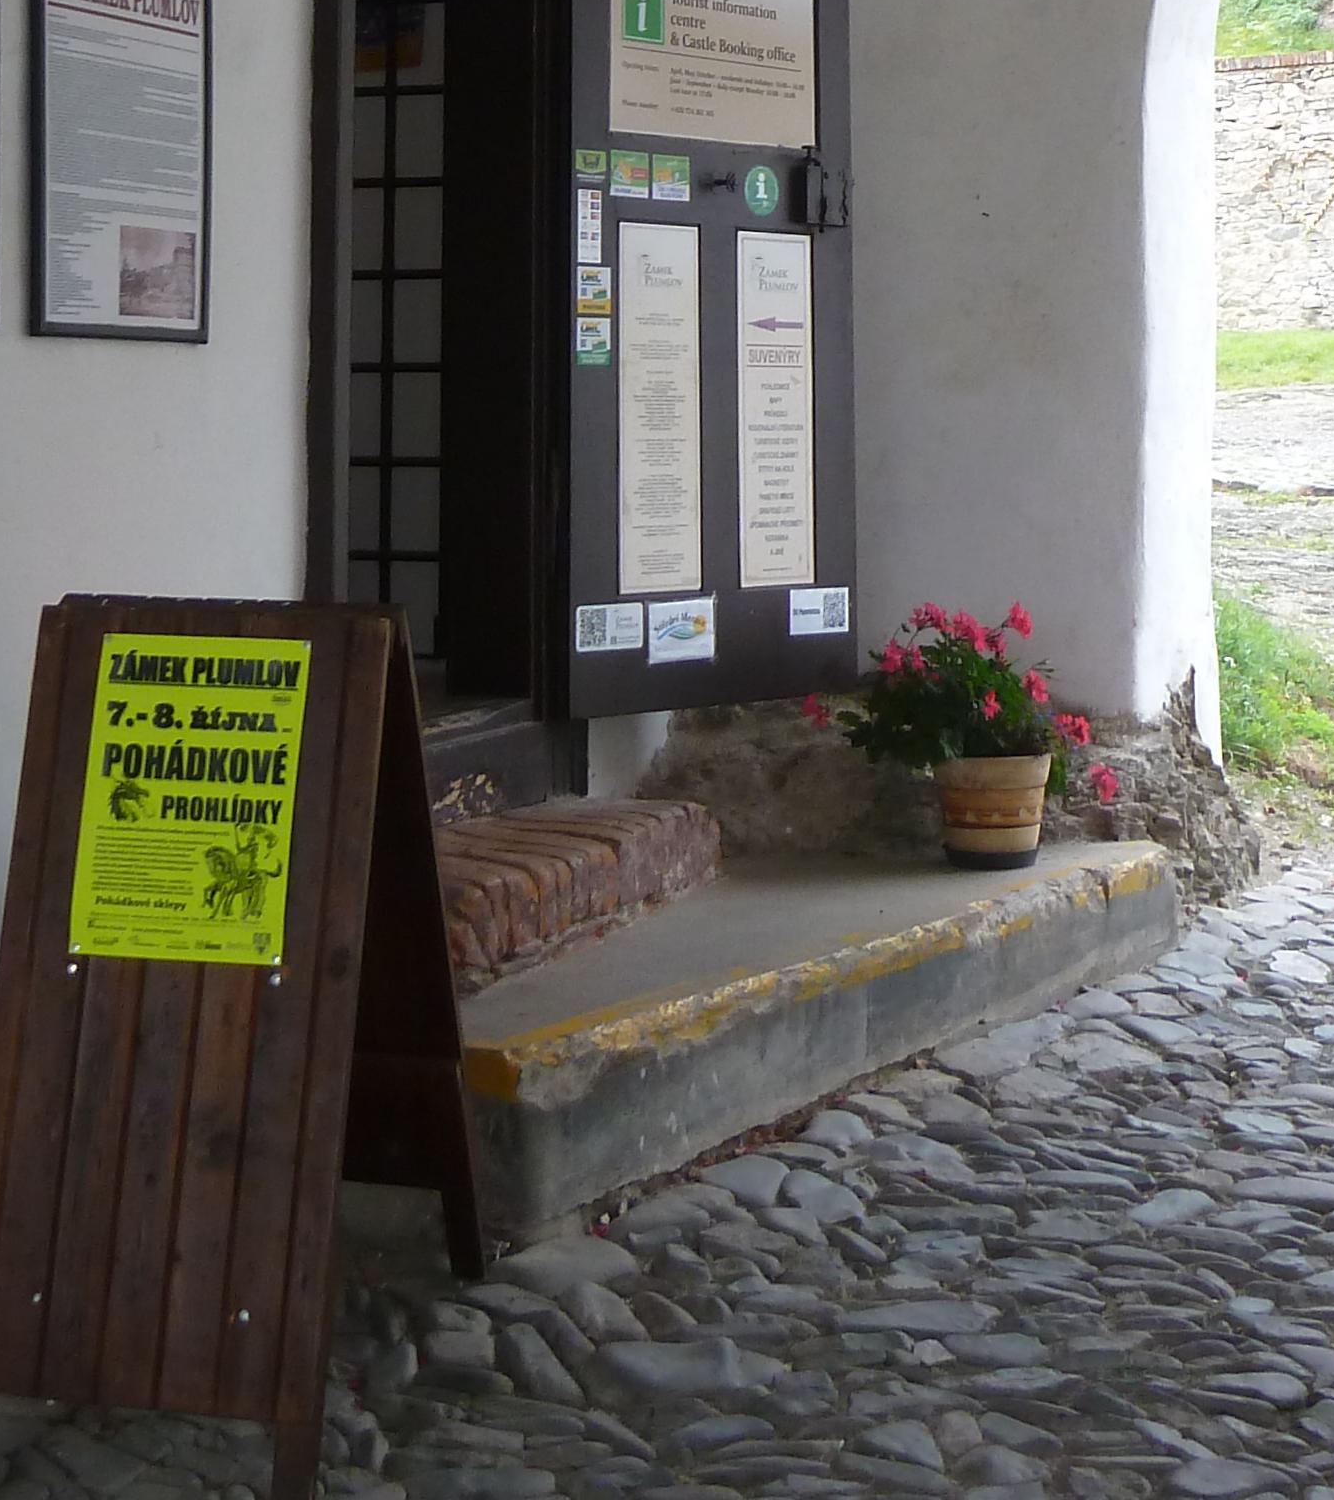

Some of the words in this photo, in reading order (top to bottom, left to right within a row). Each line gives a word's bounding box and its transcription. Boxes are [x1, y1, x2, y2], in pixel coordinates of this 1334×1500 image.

[670, 13, 707, 30] centre
[670, 31, 680, 47] &
[682, 33, 717, 53] Castle
[719, 39, 765, 62] Booking
[767, 46, 797, 64] office
[748, 347, 801, 364] SUVENÝRY
[109, 650, 188, 683] ZÁMEK
[191, 656, 302, 688] PLUMLOV
[189, 705, 278, 733] ŘÍJNA
[101, 739, 289, 786] POHÁDKOVÉ
[160, 793, 283, 826] PROHLÍDKY
